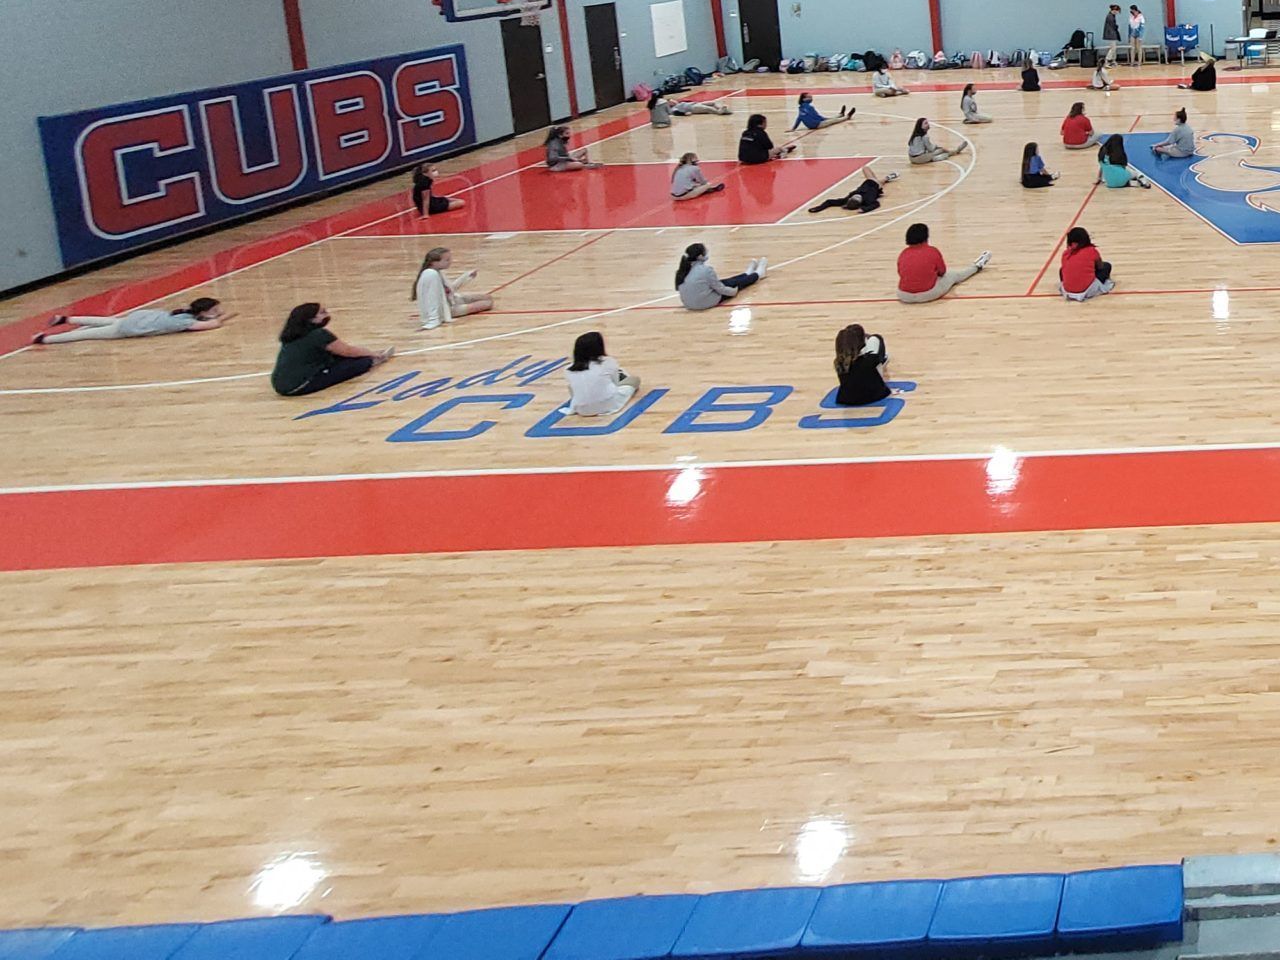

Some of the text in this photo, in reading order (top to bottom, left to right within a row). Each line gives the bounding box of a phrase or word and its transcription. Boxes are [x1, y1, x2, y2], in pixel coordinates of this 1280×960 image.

[74, 51, 466, 240] CUBS
[290, 353, 570, 421] Lady
[385, 380, 918, 443] CUBS
